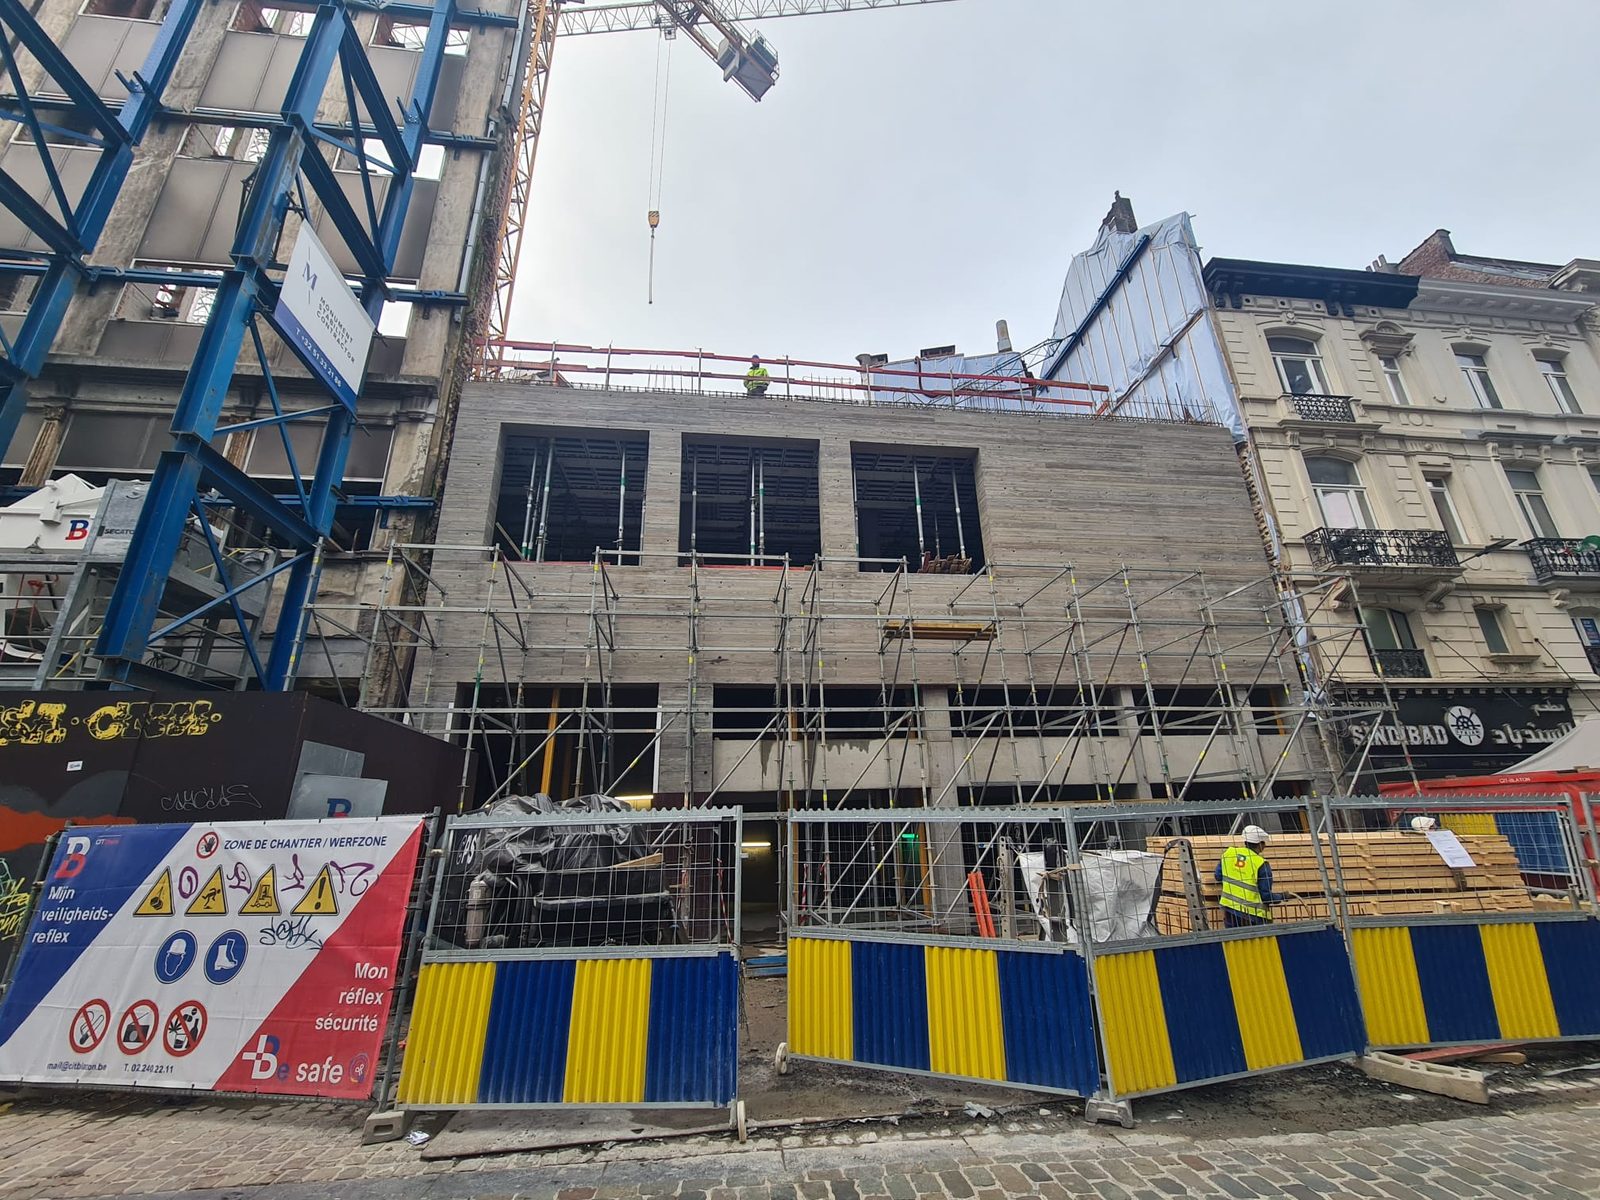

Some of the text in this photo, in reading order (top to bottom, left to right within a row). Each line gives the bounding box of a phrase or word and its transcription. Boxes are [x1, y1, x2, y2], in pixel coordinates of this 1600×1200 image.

[302, 262, 318, 291] M
[318, 303, 348, 345] STABILITY
[319, 296, 353, 343] MONUMENT
[316, 310, 355, 363] CONTRACTOR
[312, 348, 320, 361] 51
[65, 519, 89, 541] B
[224, 839, 252, 850] ZONE
[254, 839, 268, 849] DE
[269, 837, 322, 849] CHANTIER
[329, 835, 388, 848] WERFZONE
[54, 836, 91, 879] B
[47, 886, 75, 903] Mijn
[41, 906, 113, 924] veiligheids-
[31, 929, 70, 943] reflex
[354, 962, 388, 979] Mon
[338, 986, 384, 1005] réflex
[315, 1012, 378, 1032] sécurité
[131, 1063, 174, 1074] 02.240.22.11
[295, 1056, 344, 1084] safe
